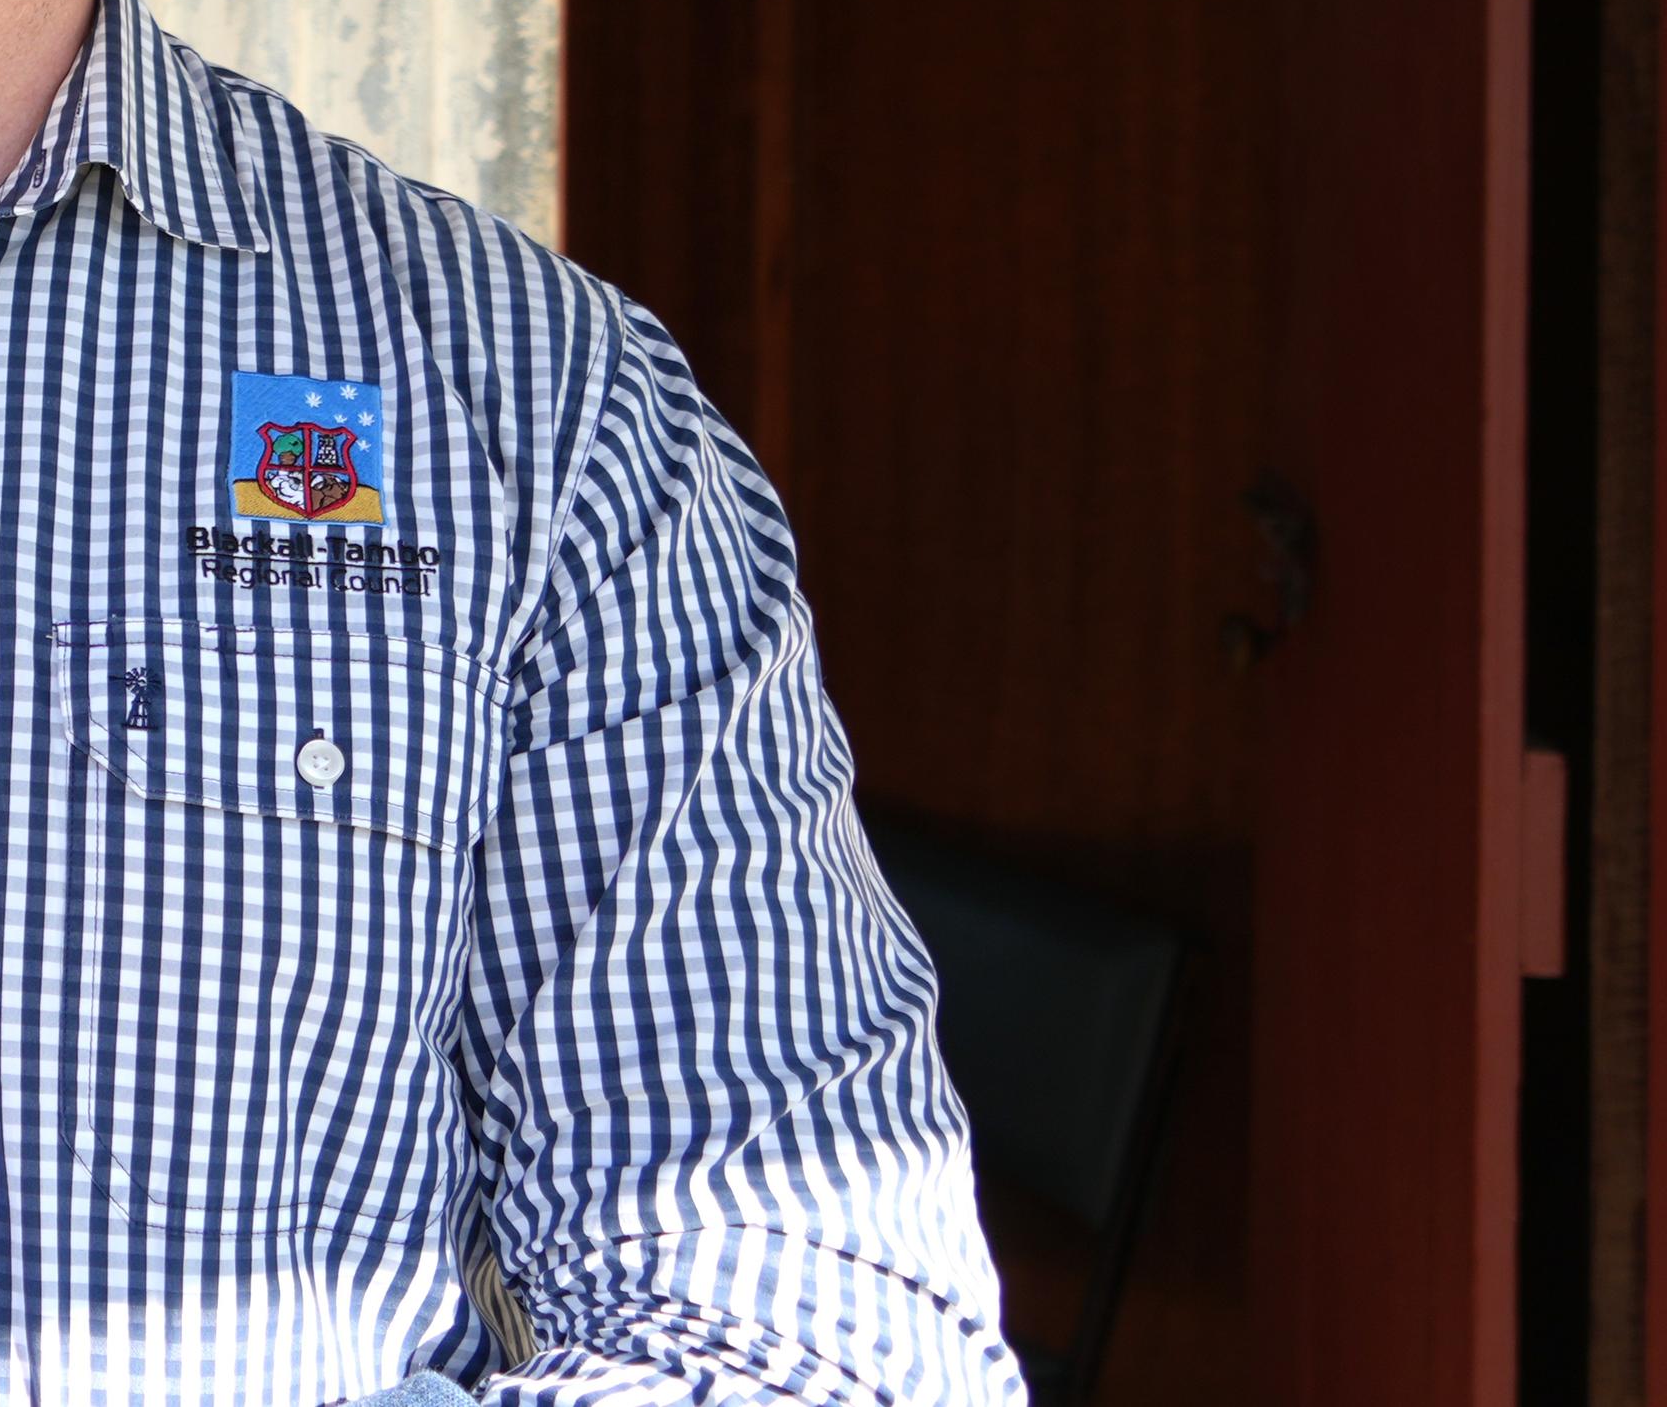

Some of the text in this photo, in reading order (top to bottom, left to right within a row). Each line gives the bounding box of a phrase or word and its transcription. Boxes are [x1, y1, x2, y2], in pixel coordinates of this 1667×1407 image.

[185, 526, 441, 566] Blackall-Tambo
[200, 558, 436, 596] Regional Council
